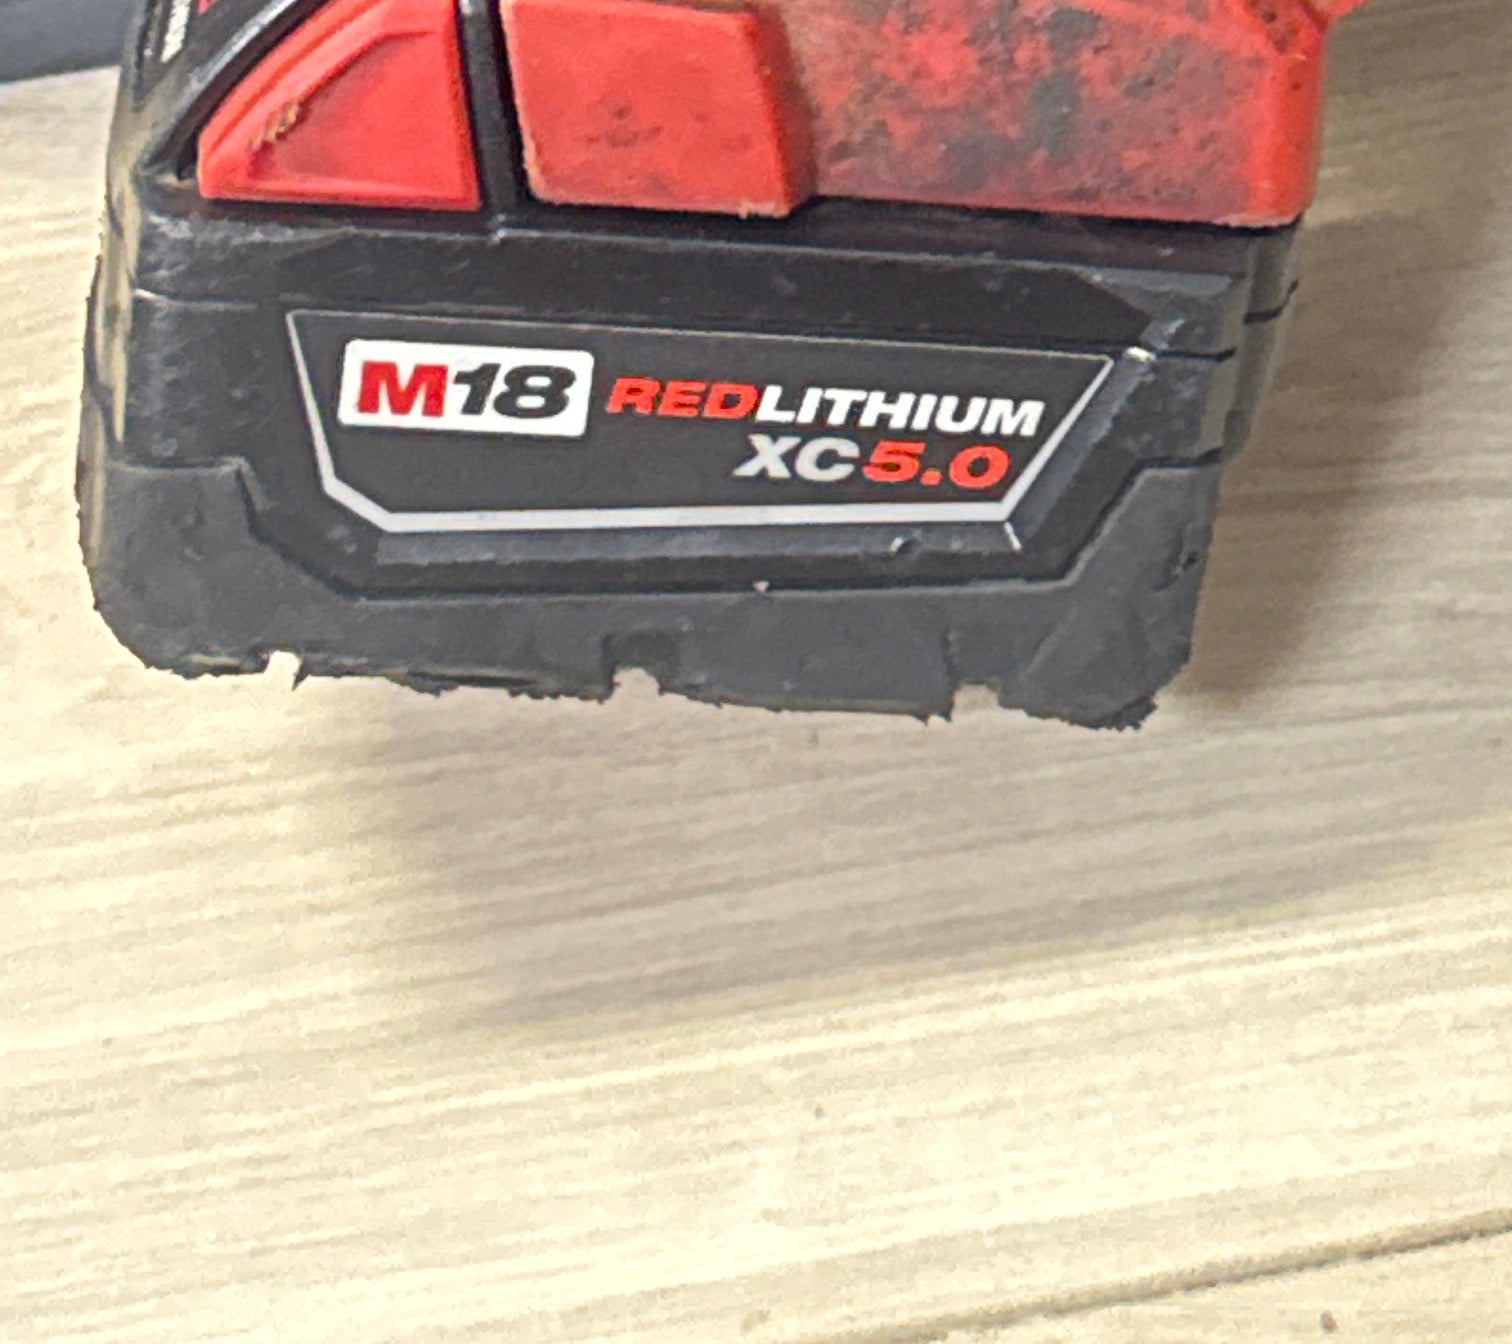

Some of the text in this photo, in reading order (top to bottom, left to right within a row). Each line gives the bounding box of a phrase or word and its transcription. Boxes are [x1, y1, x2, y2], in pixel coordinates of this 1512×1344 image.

[356, 361, 577, 420] M18
[607, 376, 1045, 437] REDLITHIUM
[732, 433, 1010, 489] XC5.0
